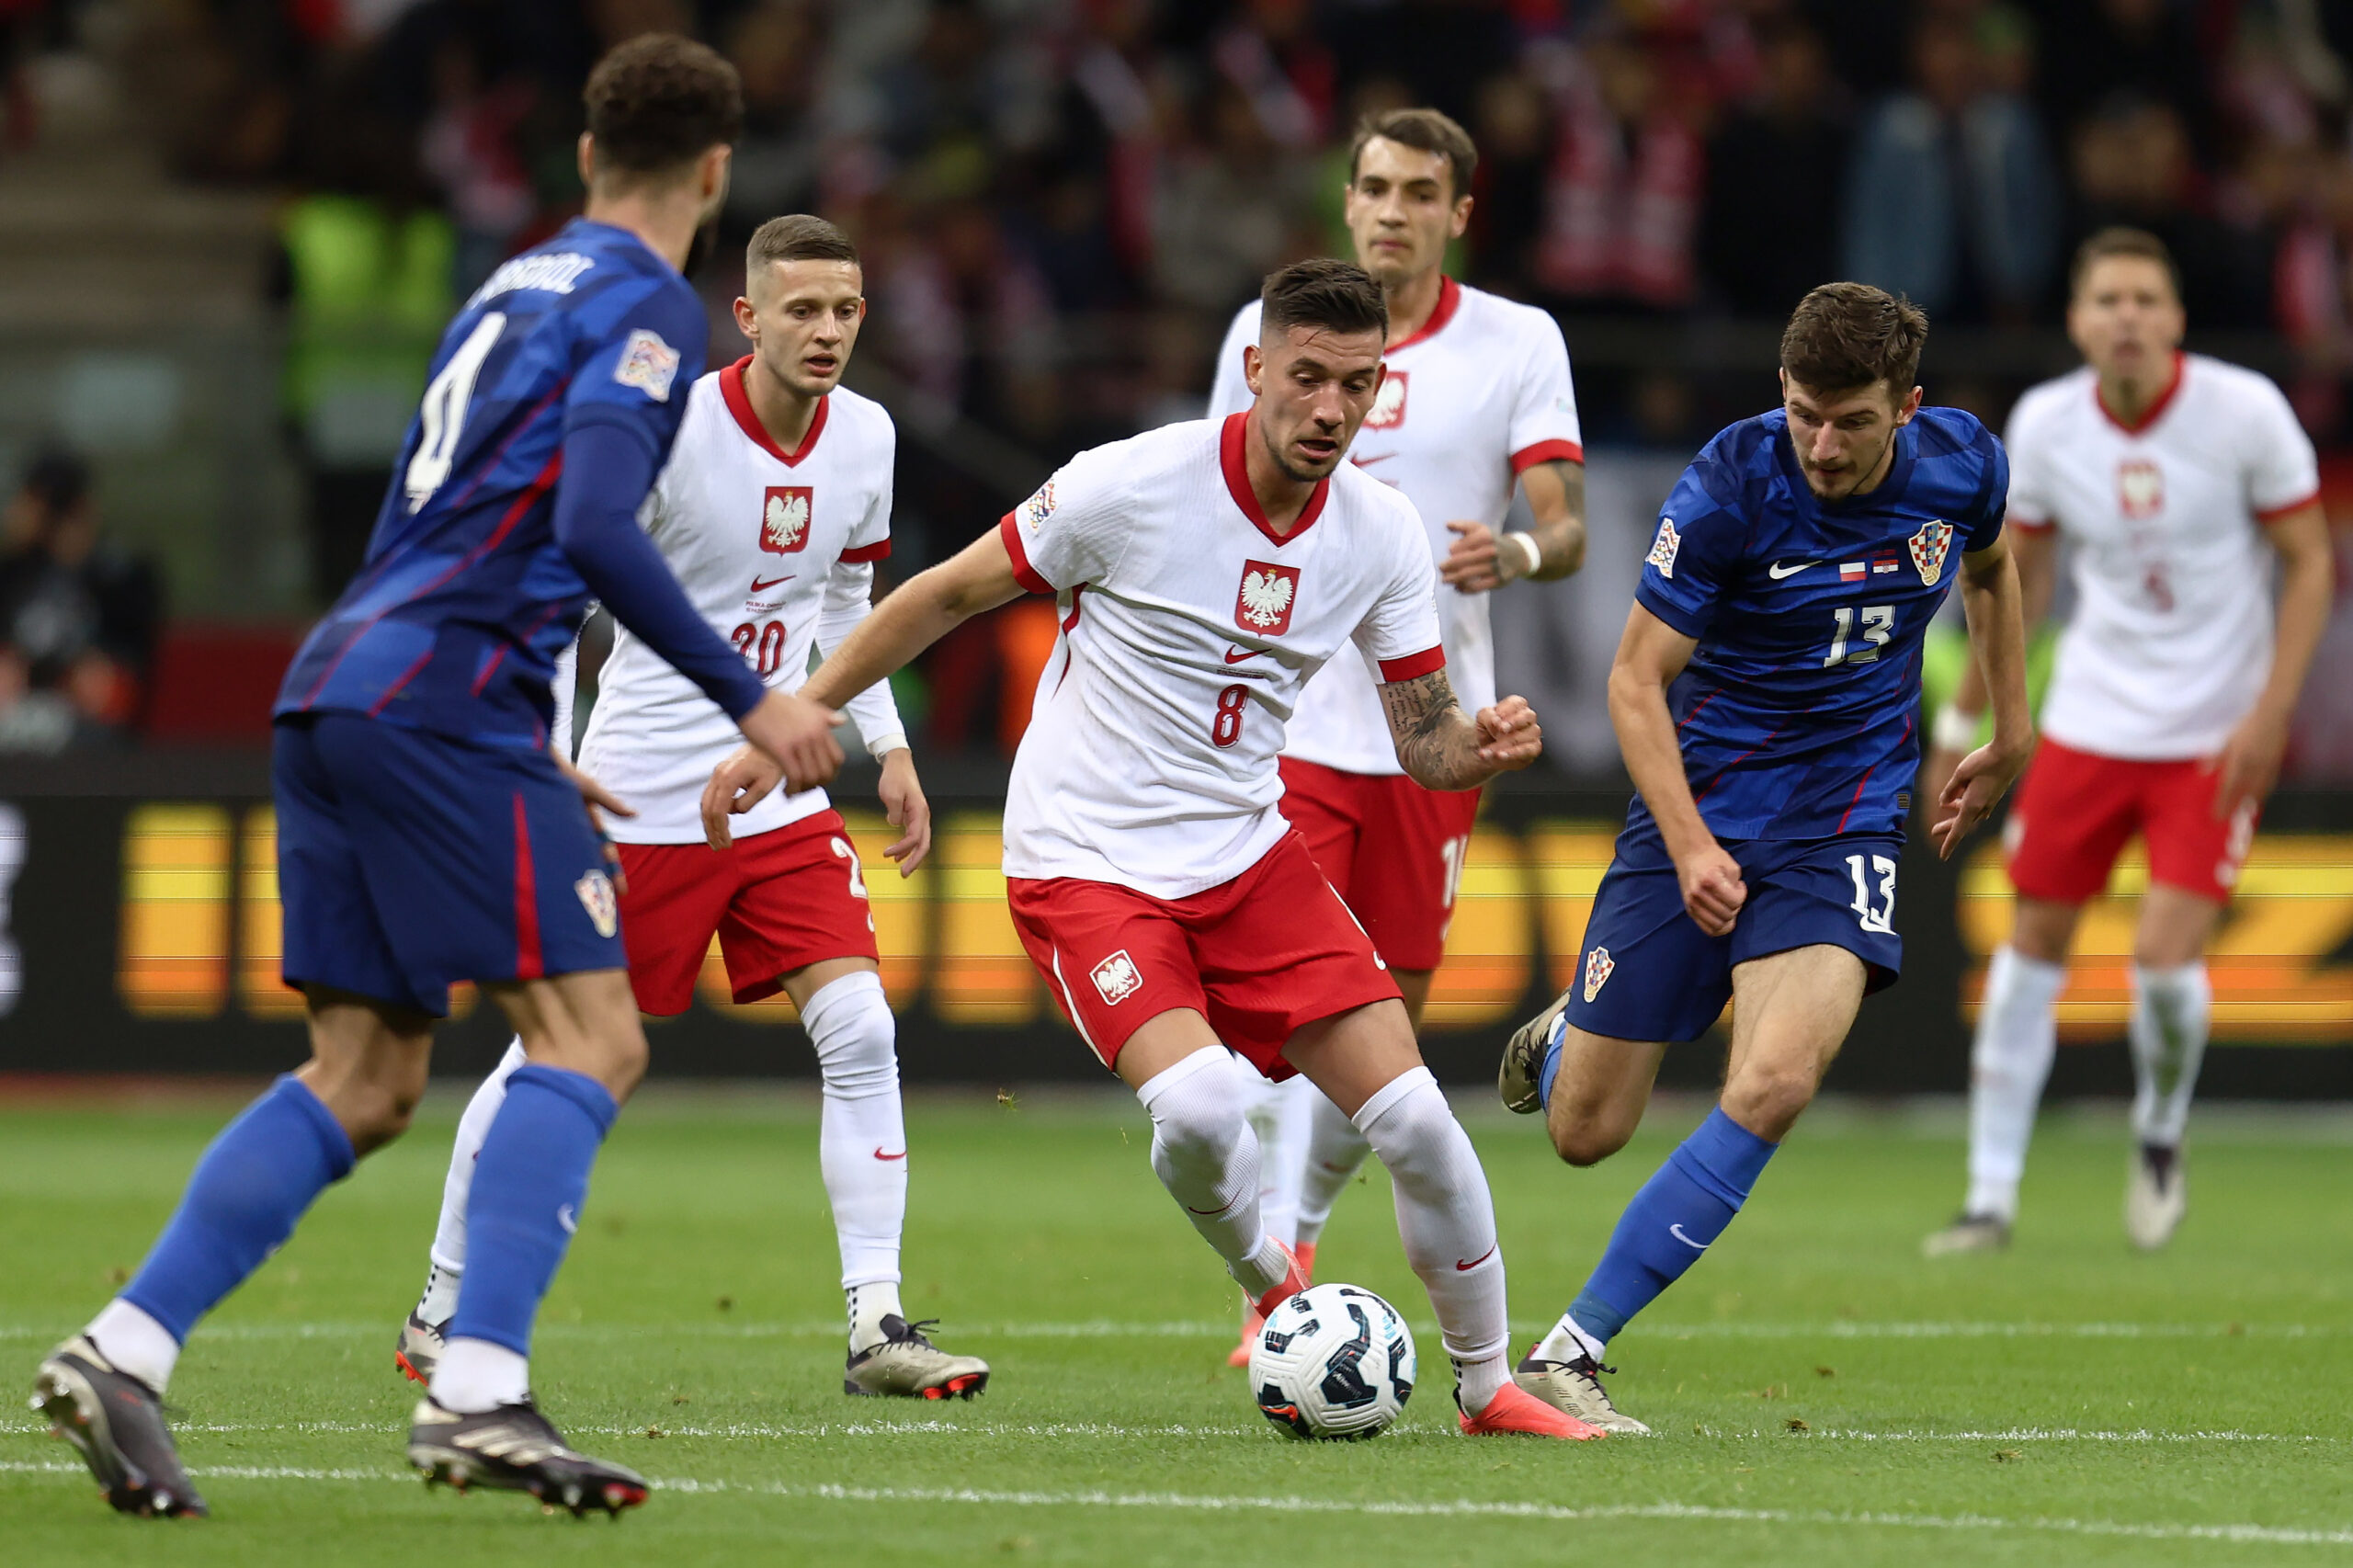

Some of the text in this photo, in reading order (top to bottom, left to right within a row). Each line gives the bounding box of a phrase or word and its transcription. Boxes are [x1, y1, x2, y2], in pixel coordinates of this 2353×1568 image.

[404, 312, 506, 515] 4
[1824, 605, 1895, 668] 13
[1211, 683, 1250, 748] 8
[1845, 854, 1896, 930] 13
